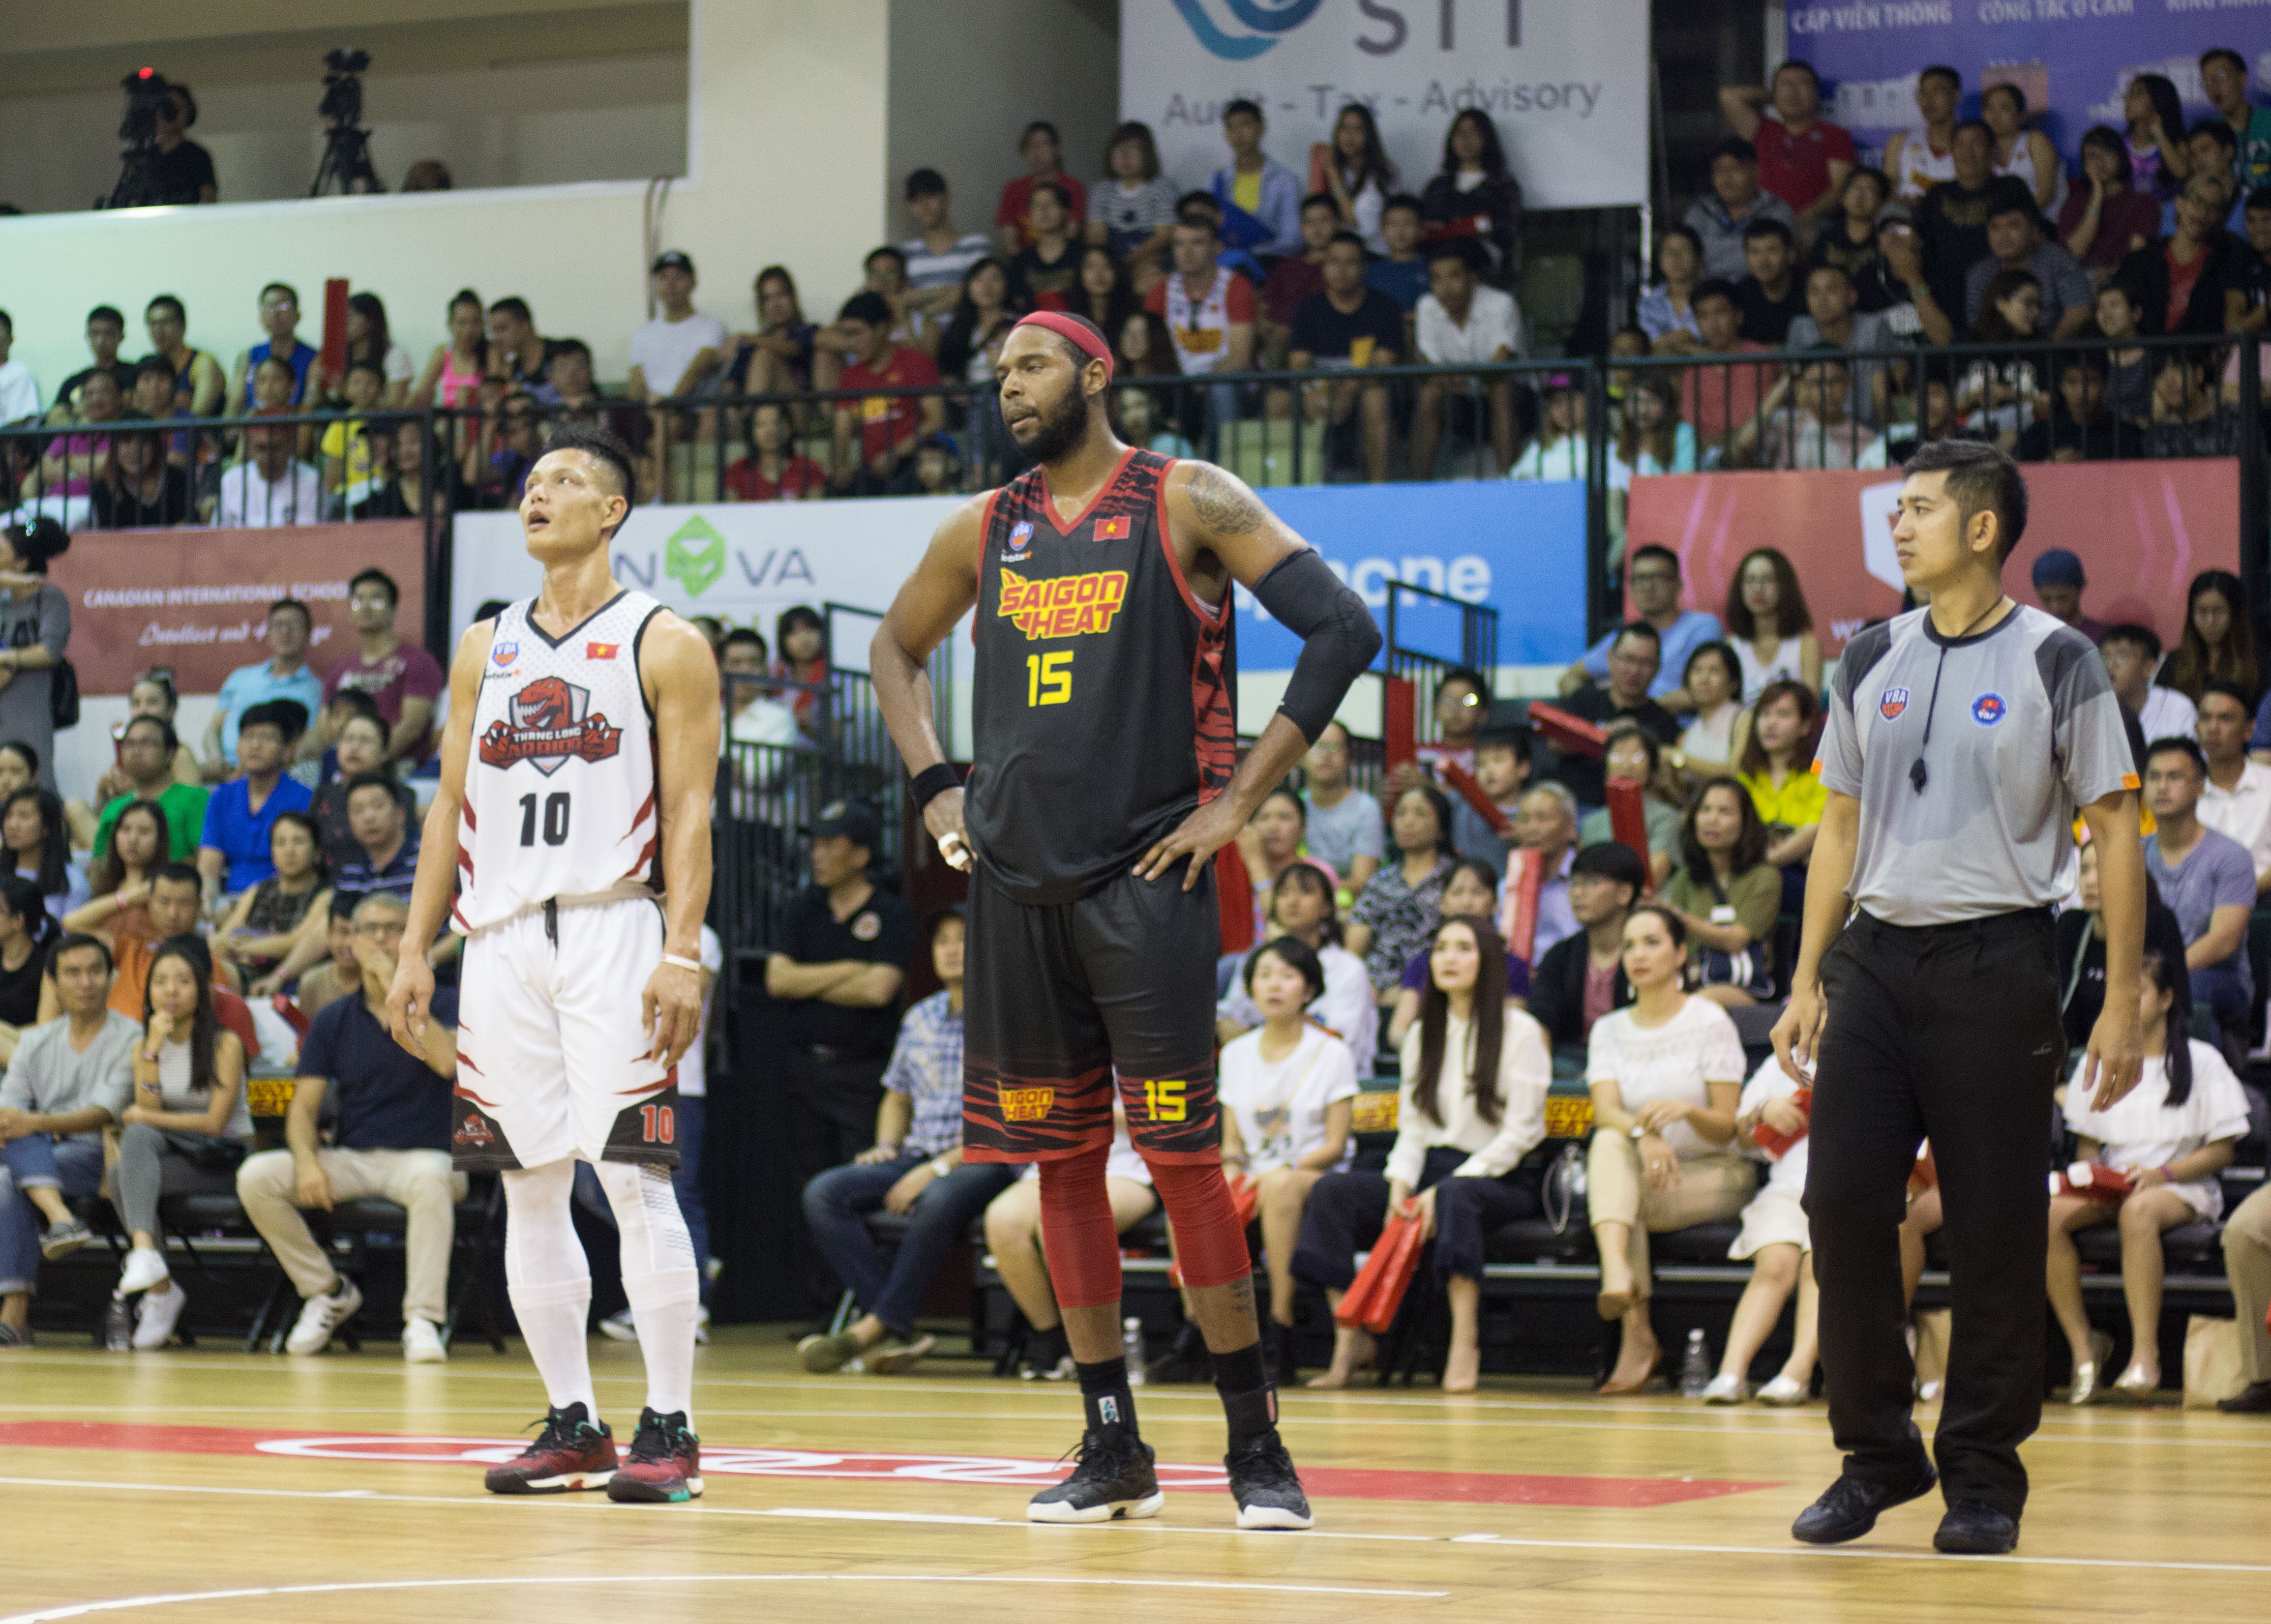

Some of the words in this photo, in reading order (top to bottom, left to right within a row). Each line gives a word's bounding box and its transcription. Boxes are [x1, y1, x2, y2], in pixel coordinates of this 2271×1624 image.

[1419, 78, 1603, 119] Advisory
[84, 589, 164, 608] CANADIAN
[166, 585, 286, 605] INTERNATIONAL
[289, 582, 349, 601] SCHOO
[998, 570, 1128, 617] SAIGON
[1027, 602, 1120, 640] HEAT
[1026, 650, 1074, 707] 15
[1885, 689, 1906, 703] VBA
[555, 727, 582, 739] LONG
[519, 792, 570, 846] 10
[1144, 1080, 1186, 1121] 15
[640, 1104, 675, 1144] 10
